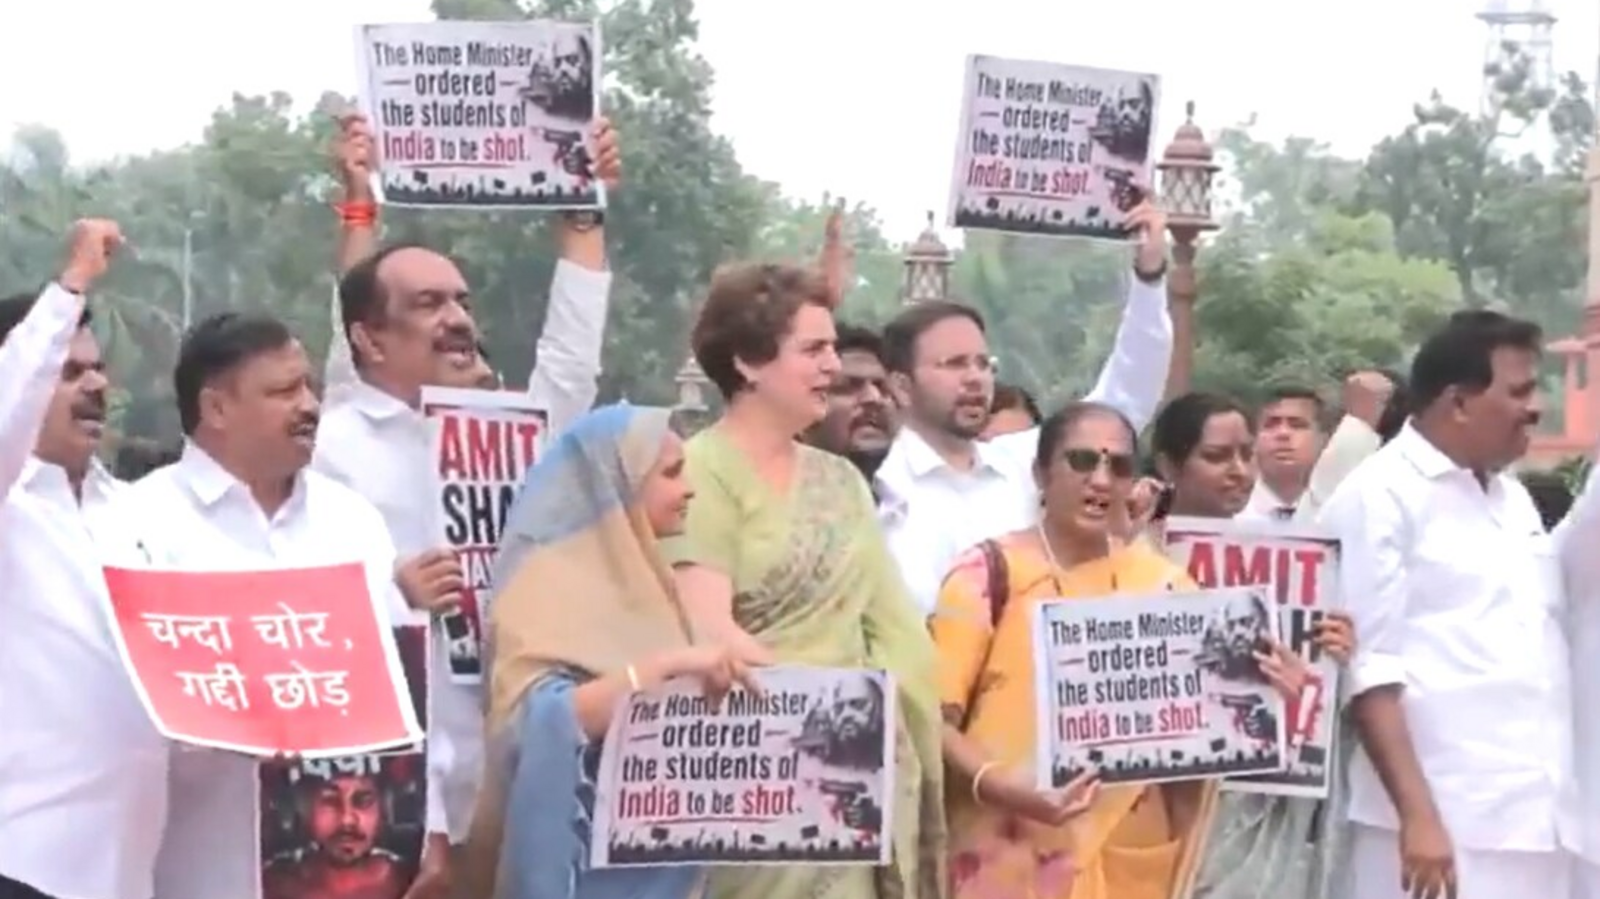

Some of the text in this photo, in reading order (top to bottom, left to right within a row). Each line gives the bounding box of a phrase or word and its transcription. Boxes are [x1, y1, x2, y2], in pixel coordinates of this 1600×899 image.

[373, 42, 533, 66] The Home Minister
[415, 71, 496, 96] ordered
[977, 73, 1103, 107] The Home Minister
[381, 99, 526, 127] the students of
[1002, 106, 1070, 132] ordered
[384, 131, 531, 161] India to be shot.
[972, 129, 1093, 163] the students of
[967, 159, 1092, 195] India to be shot.
[439, 415, 538, 481] AMIT
[1187, 541, 1324, 606] AMIT
[141, 612, 232, 654] चन्दा
[1051, 611, 1203, 645] The Home Minister
[1088, 642, 1168, 673] ordered
[175, 660, 349, 716] गद्दी छोड़
[1057, 668, 1201, 707] the students of
[630, 702, 660, 724] The
[727, 690, 808, 717] Minister
[1057, 705, 1209, 741] India to be shot.
[662, 719, 761, 748] ordered
[622, 752, 799, 782] the students of
[618, 784, 803, 818] India to be shot.
